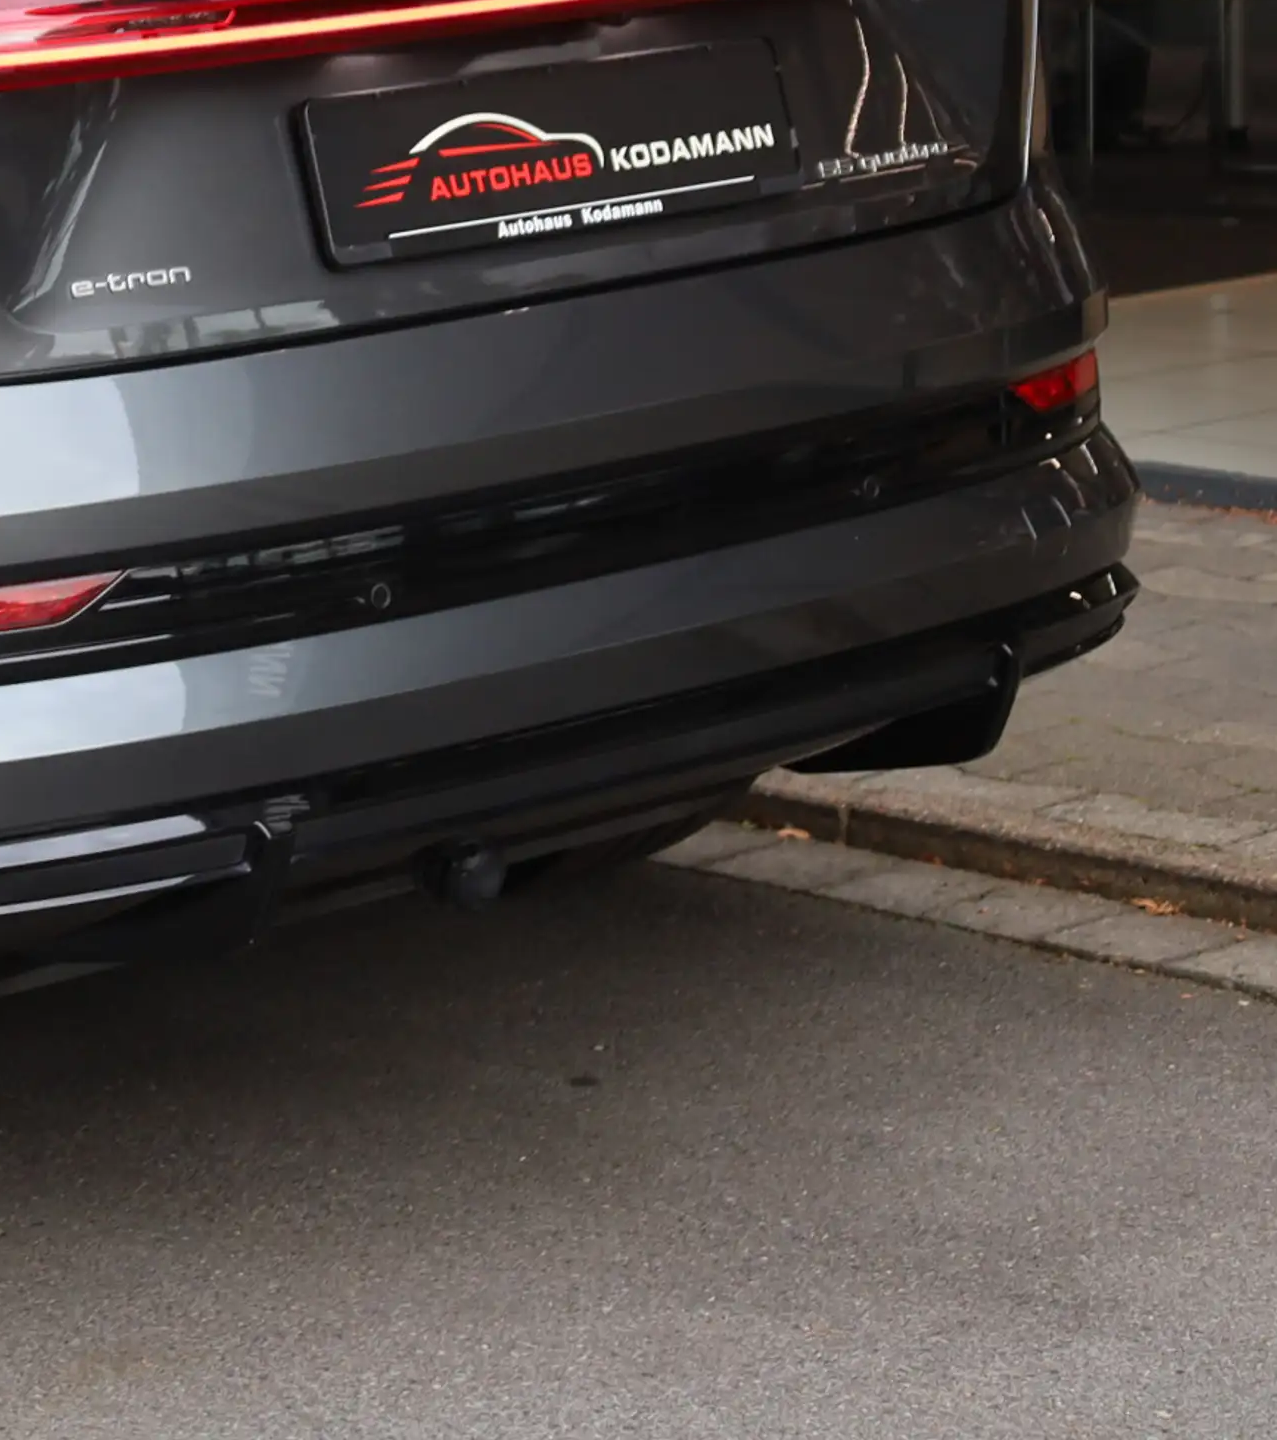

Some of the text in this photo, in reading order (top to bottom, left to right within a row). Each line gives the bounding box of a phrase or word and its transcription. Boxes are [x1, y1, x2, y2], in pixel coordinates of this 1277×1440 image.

[430, 123, 776, 201] AUTOHAUS KODAMANN
[498, 198, 664, 239] Autohaus Kodamann
[71, 266, 191, 298] e-tron
